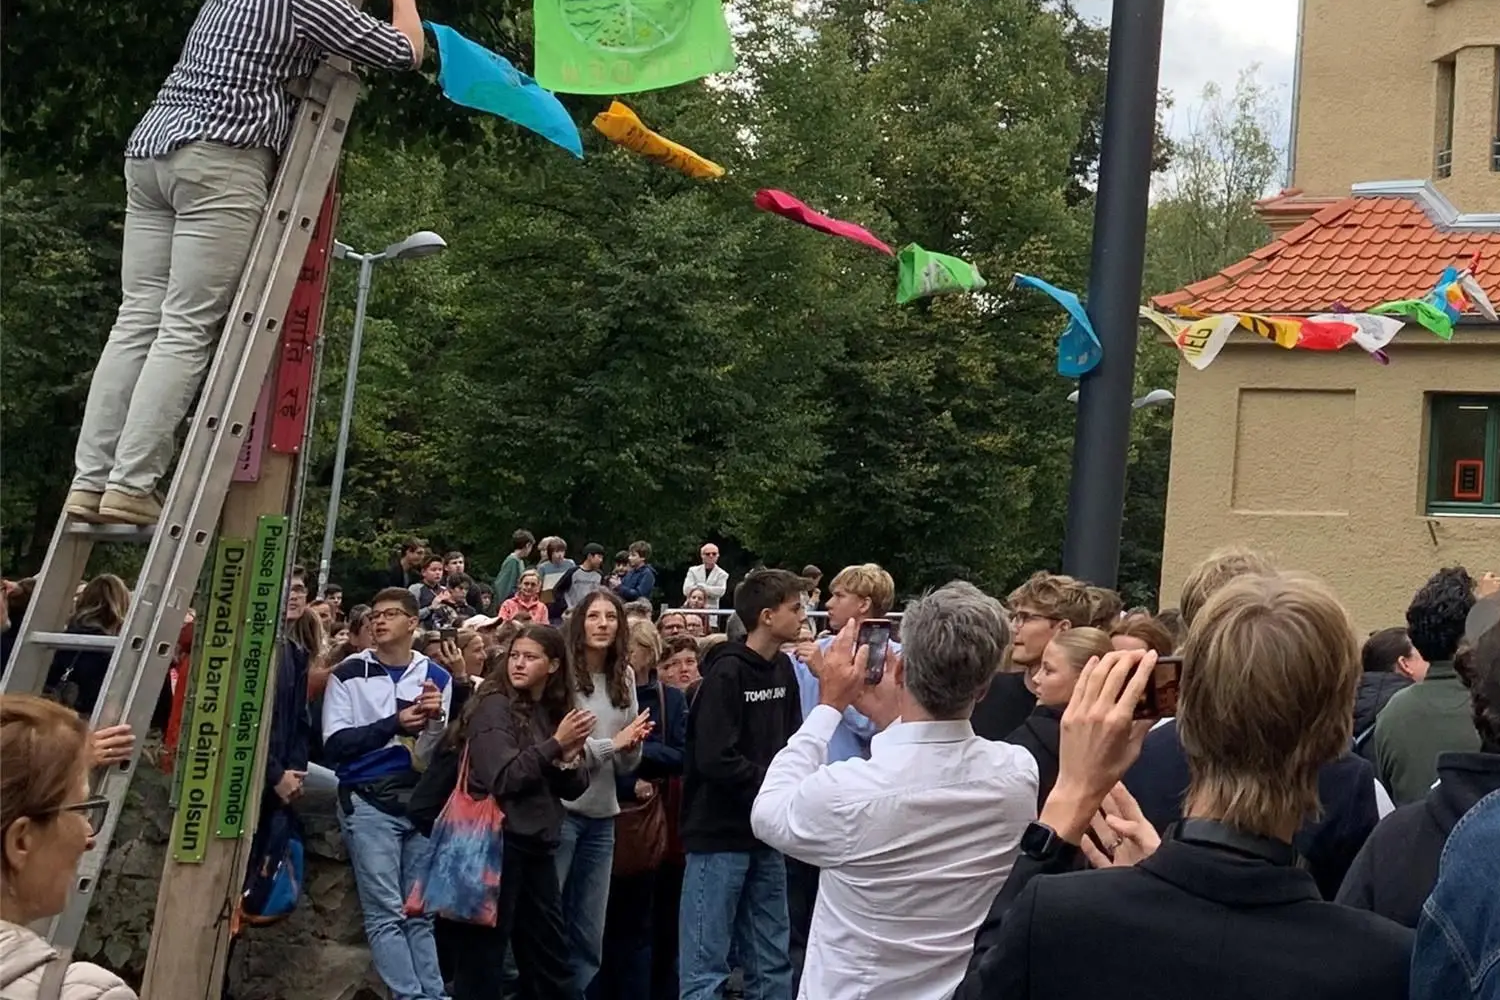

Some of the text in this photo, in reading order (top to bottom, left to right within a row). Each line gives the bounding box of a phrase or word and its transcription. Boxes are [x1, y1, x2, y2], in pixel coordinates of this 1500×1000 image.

[280, 388, 302, 421] रहे
[182, 547, 244, 850] Dünyada barış daim olsun
[225, 525, 282, 825] Puisse la paix régner dans le monde
[744, 689, 773, 702] TOMMY
